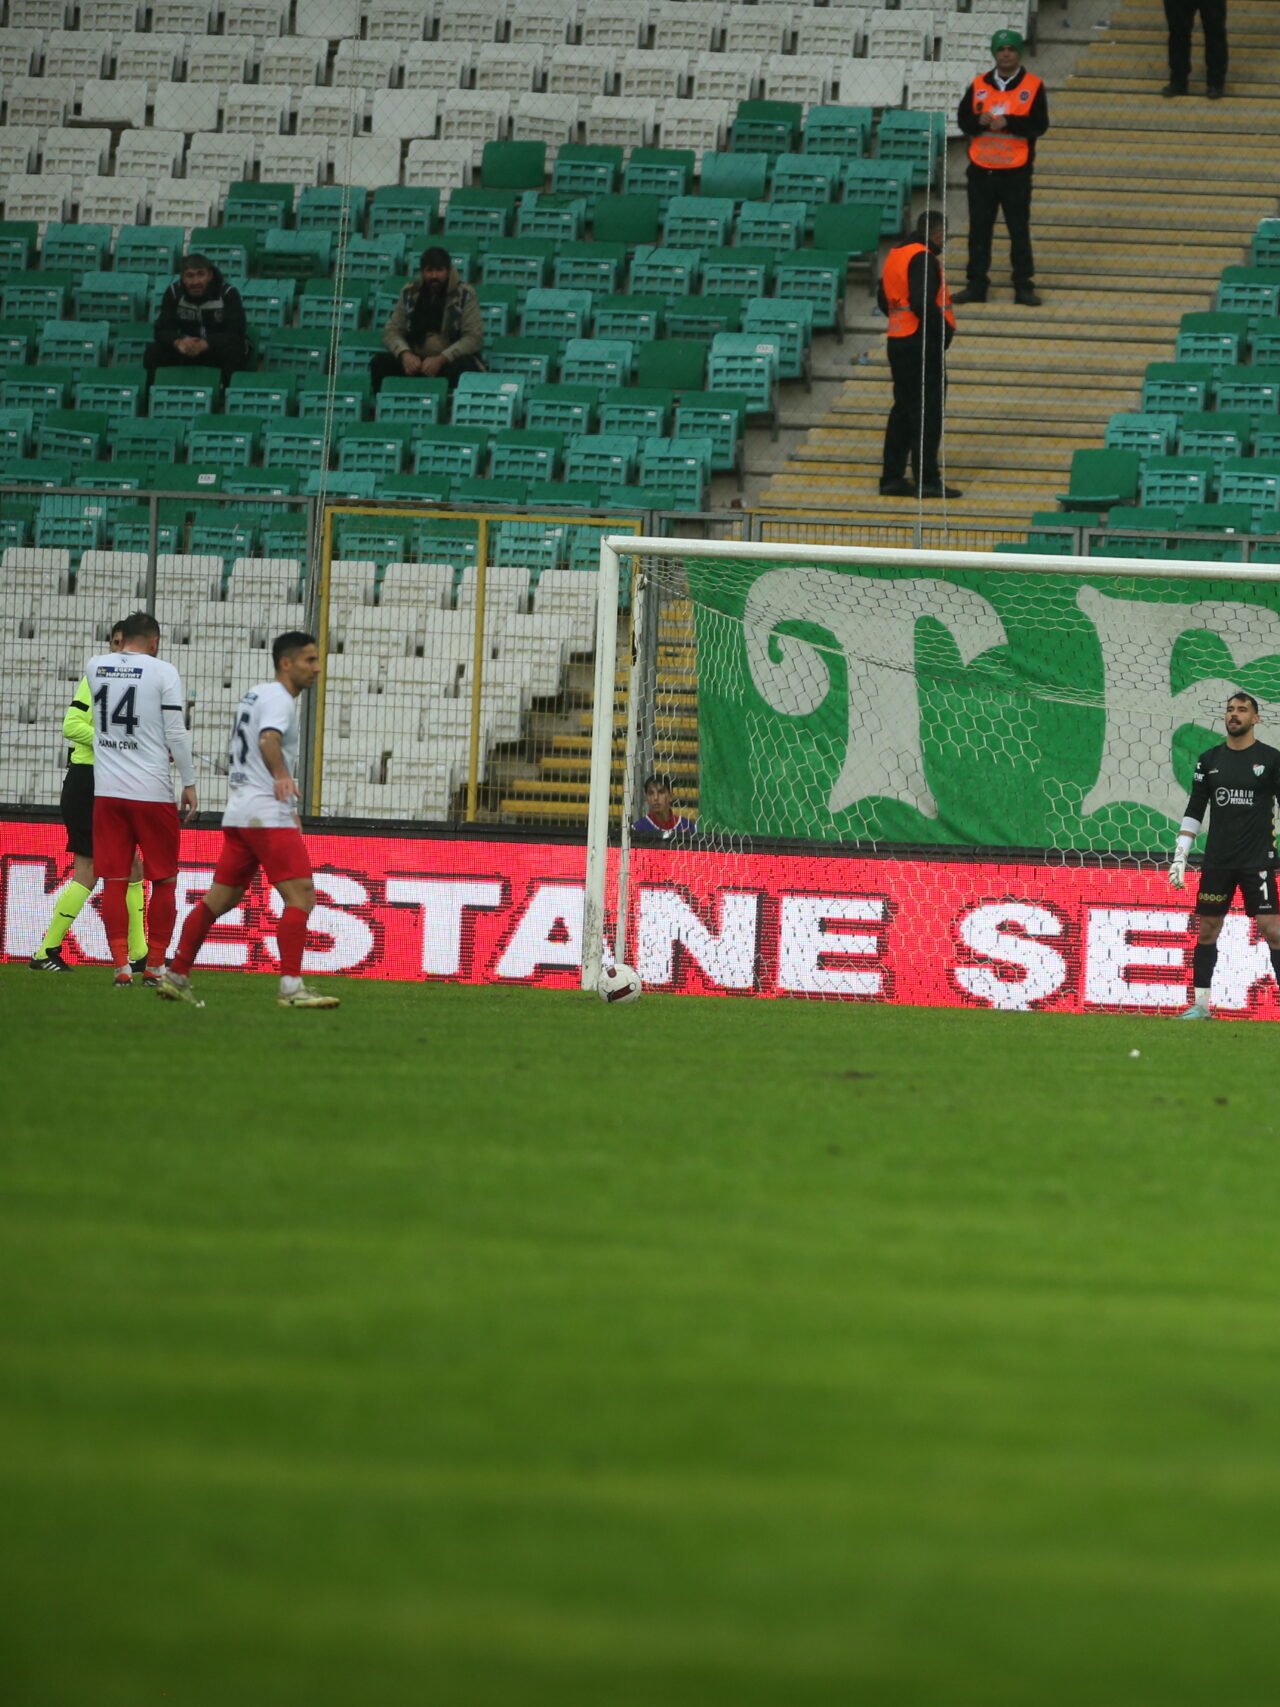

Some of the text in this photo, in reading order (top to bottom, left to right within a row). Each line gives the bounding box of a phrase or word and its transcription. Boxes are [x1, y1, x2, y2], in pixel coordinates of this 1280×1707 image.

[93, 683, 139, 736] 14
[1259, 881, 1269, 901] 1
[3, 861, 889, 993] KESTANE
